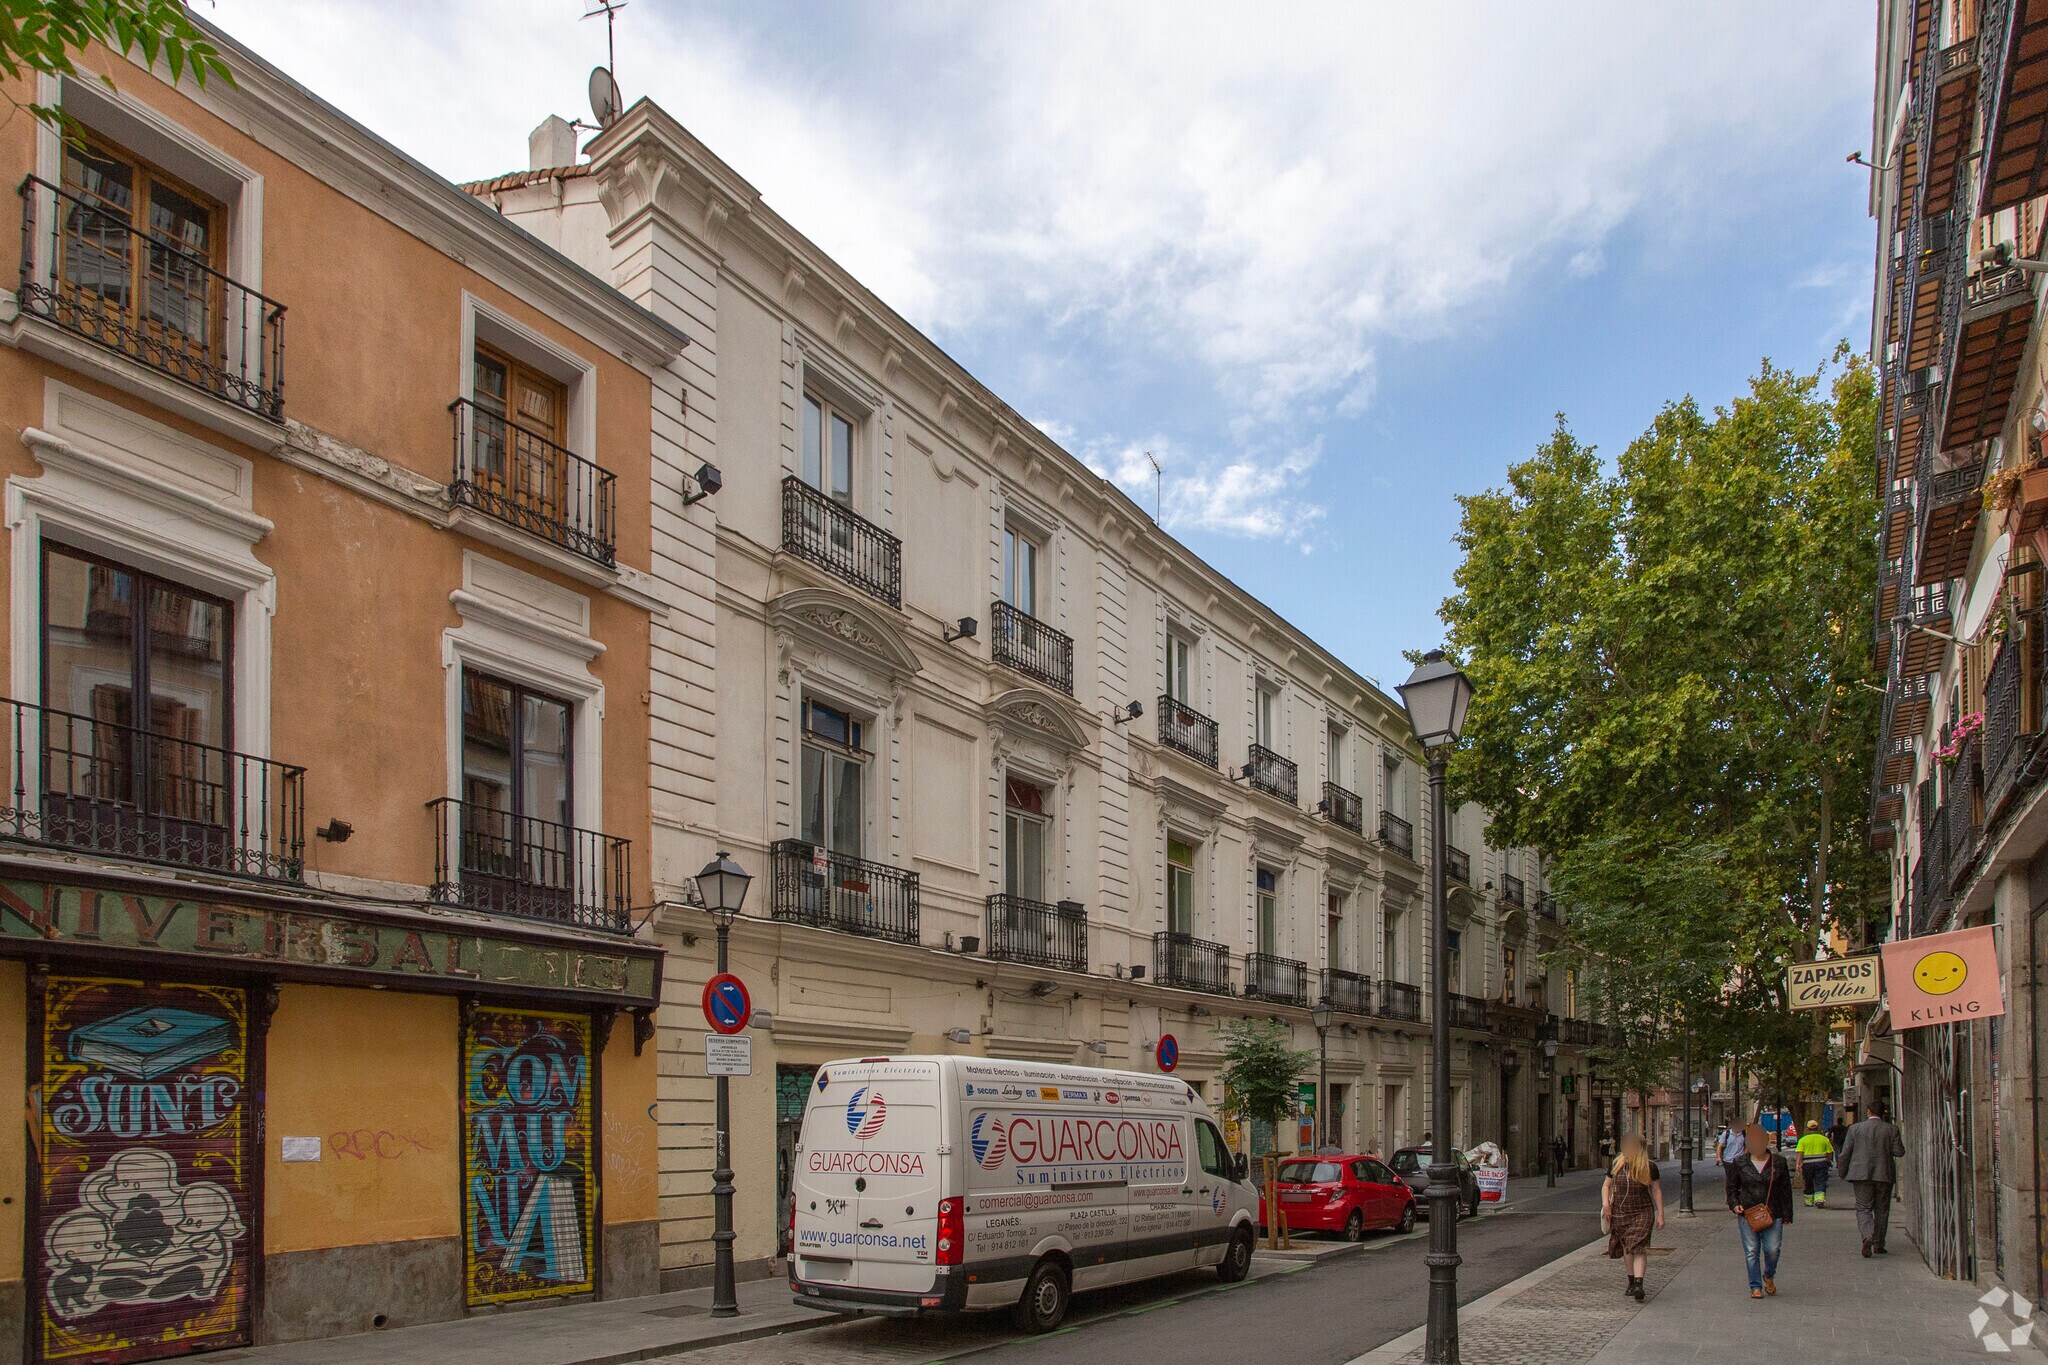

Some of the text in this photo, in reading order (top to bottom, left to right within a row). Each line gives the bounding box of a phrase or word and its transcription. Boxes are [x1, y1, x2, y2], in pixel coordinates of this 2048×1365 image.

[1793, 963, 1872, 985] ZAPATOS
[1799, 981, 1867, 1004] Ayllón
[1911, 1001, 1981, 1022] KLING
[832, 1066, 932, 1076] Suministros Eléctricos
[966, 1065, 992, 1075] Material
[977, 1087, 999, 1095] secom
[1063, 1091, 1087, 1099] FERMAX
[53, 1074, 240, 1138] SUNT
[1008, 1118, 1184, 1163] GUARCONSA
[809, 1152, 924, 1174] GUARCONSA
[1016, 1165, 1185, 1185] Suministros Eléctricos
[980, 1191, 1093, 1209] comercial@guarconsa.com
[1133, 1186, 1179, 1199] www.guarconsa.net
[986, 1216, 1021, 1228] LEGANÉS:
[1070, 1209, 1117, 1220] PLAZA CASTILLA:
[1065, 1222, 1081, 1231] Paseo
[1082, 1221, 1089, 1229] de
[1090, 1220, 1095, 1228] la
[800, 1229, 927, 1249] www.guarconsa.net
[968, 1233, 976, 1242] C/
[977, 1230, 1005, 1241] Eduardo
[1029, 1227, 1037, 1236] 23
[991, 1242, 1003, 1252] 914
[1004, 1240, 1016, 1250] 812
[1018, 1239, 1029, 1248] 161
